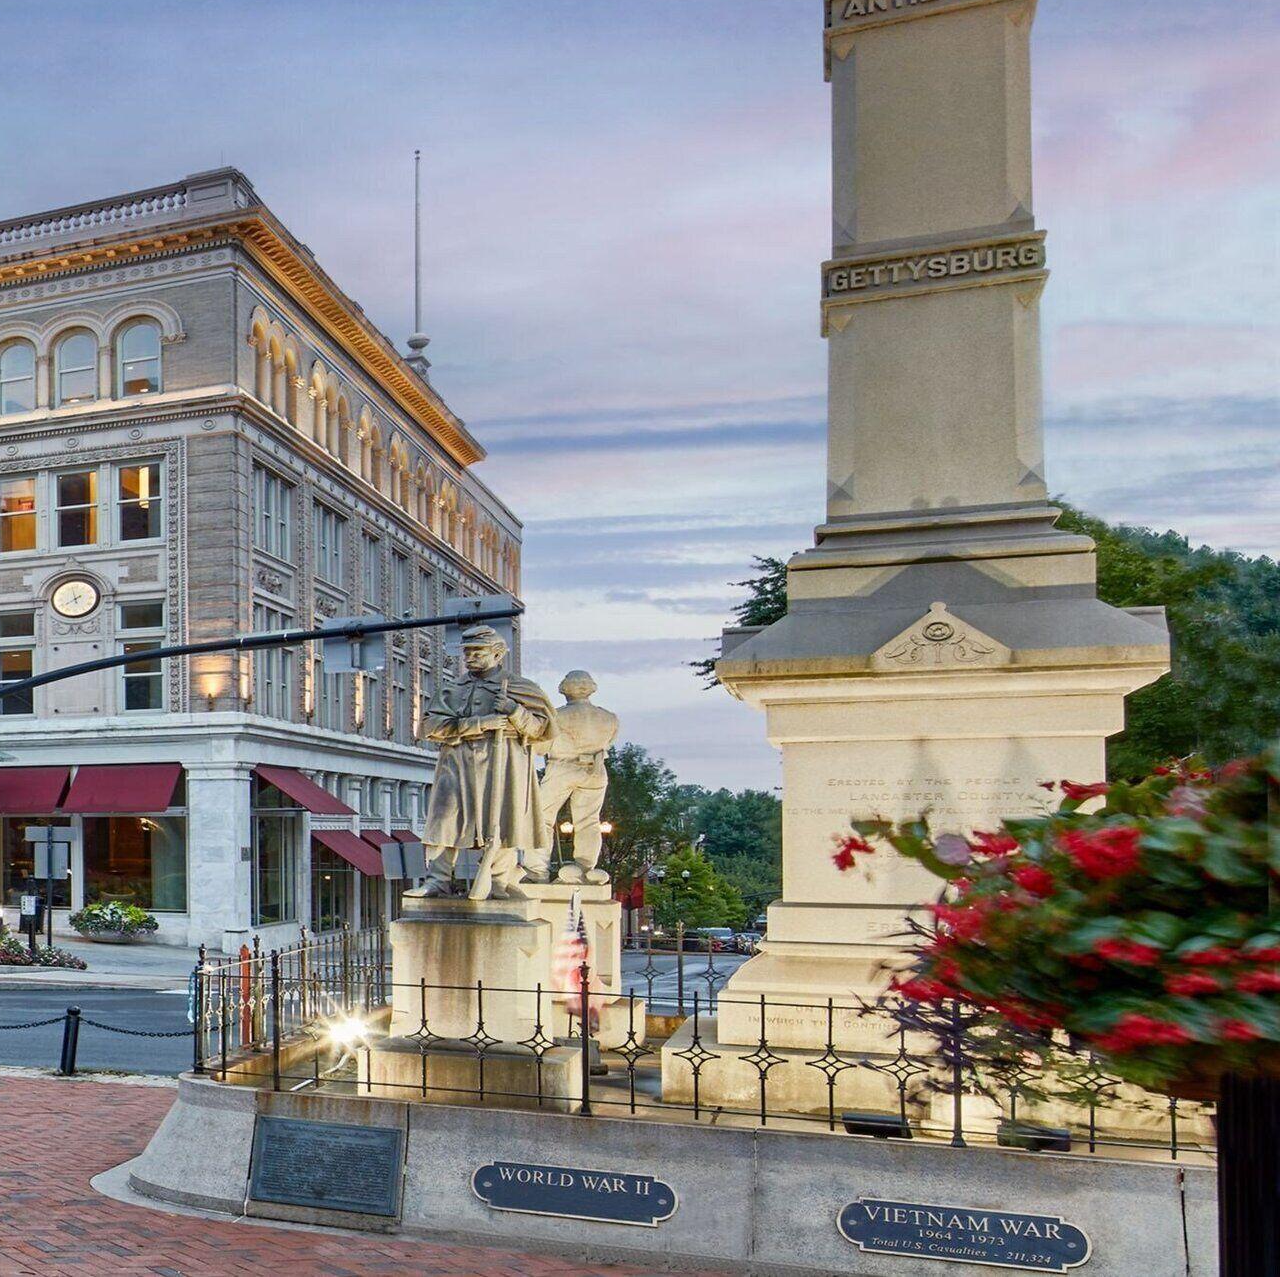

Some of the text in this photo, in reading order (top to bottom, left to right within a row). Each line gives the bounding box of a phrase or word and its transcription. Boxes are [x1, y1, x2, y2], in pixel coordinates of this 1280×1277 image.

[831, 244, 1040, 293] GETTYSBURG
[925, 778, 952, 786] THE
[849, 791, 945, 801] LANCASTER
[498, 1167, 651, 1196] WORLD WAR II
[863, 1206, 1064, 1240] VIETNAM WAR
[872, 1237, 898, 1248] Total
[902, 1240, 924, 1250] U.S.
[928, 1243, 987, 1258] Casualties
[1006, 1251, 1052, 1264] 211,324
[918, 1228, 952, 1240] 1964
[970, 1234, 1006, 1246] 1973
